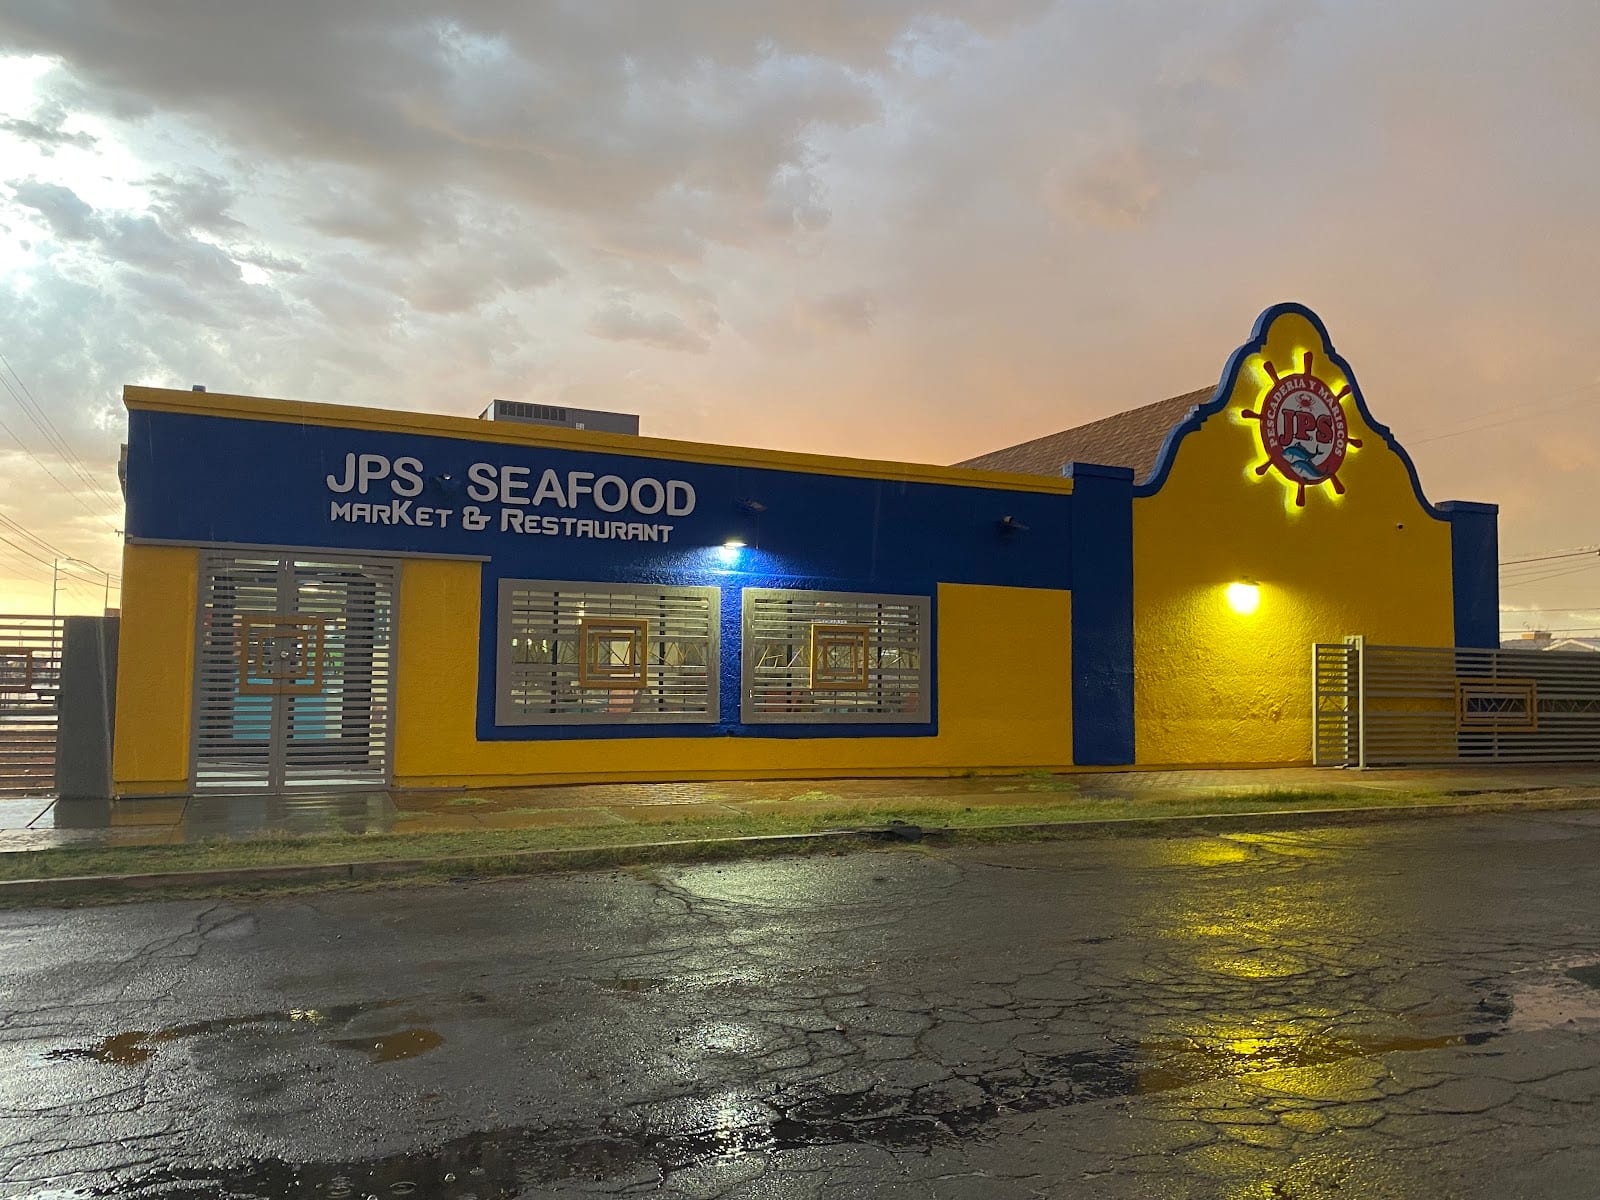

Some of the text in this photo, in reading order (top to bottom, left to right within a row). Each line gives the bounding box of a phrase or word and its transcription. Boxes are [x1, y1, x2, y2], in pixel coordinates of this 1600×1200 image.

[1267, 379, 1344, 456] PESCADERIA Y MARISCOS
[326, 453, 695, 516] JPS SEAFOOD
[330, 500, 673, 542] MARKET & RESTAURANT
